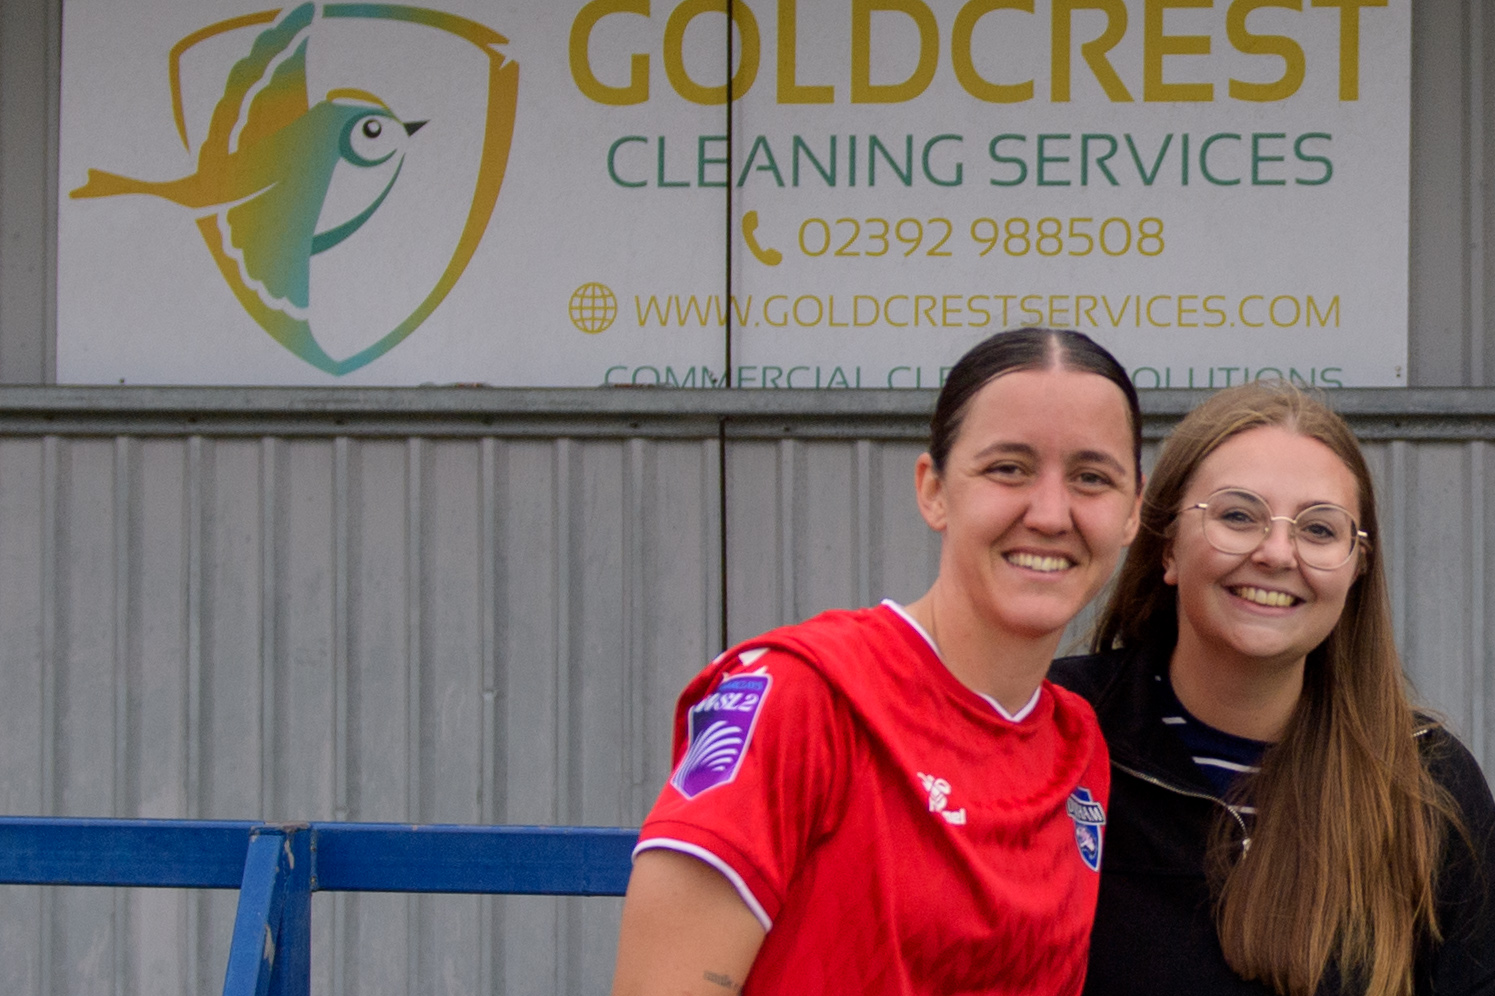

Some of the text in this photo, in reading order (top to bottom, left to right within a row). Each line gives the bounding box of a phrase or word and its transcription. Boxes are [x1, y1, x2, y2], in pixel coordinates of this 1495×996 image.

[567, 0, 1389, 106] GOLDCREST
[606, 132, 1335, 188] CLEANING SERVICES
[798, 216, 1167, 258] 02392 988508
[634, 294, 1342, 329] WWW.GOLDCRESTSERVICES.COM
[1130, 366, 1344, 388] OLUTIONS
